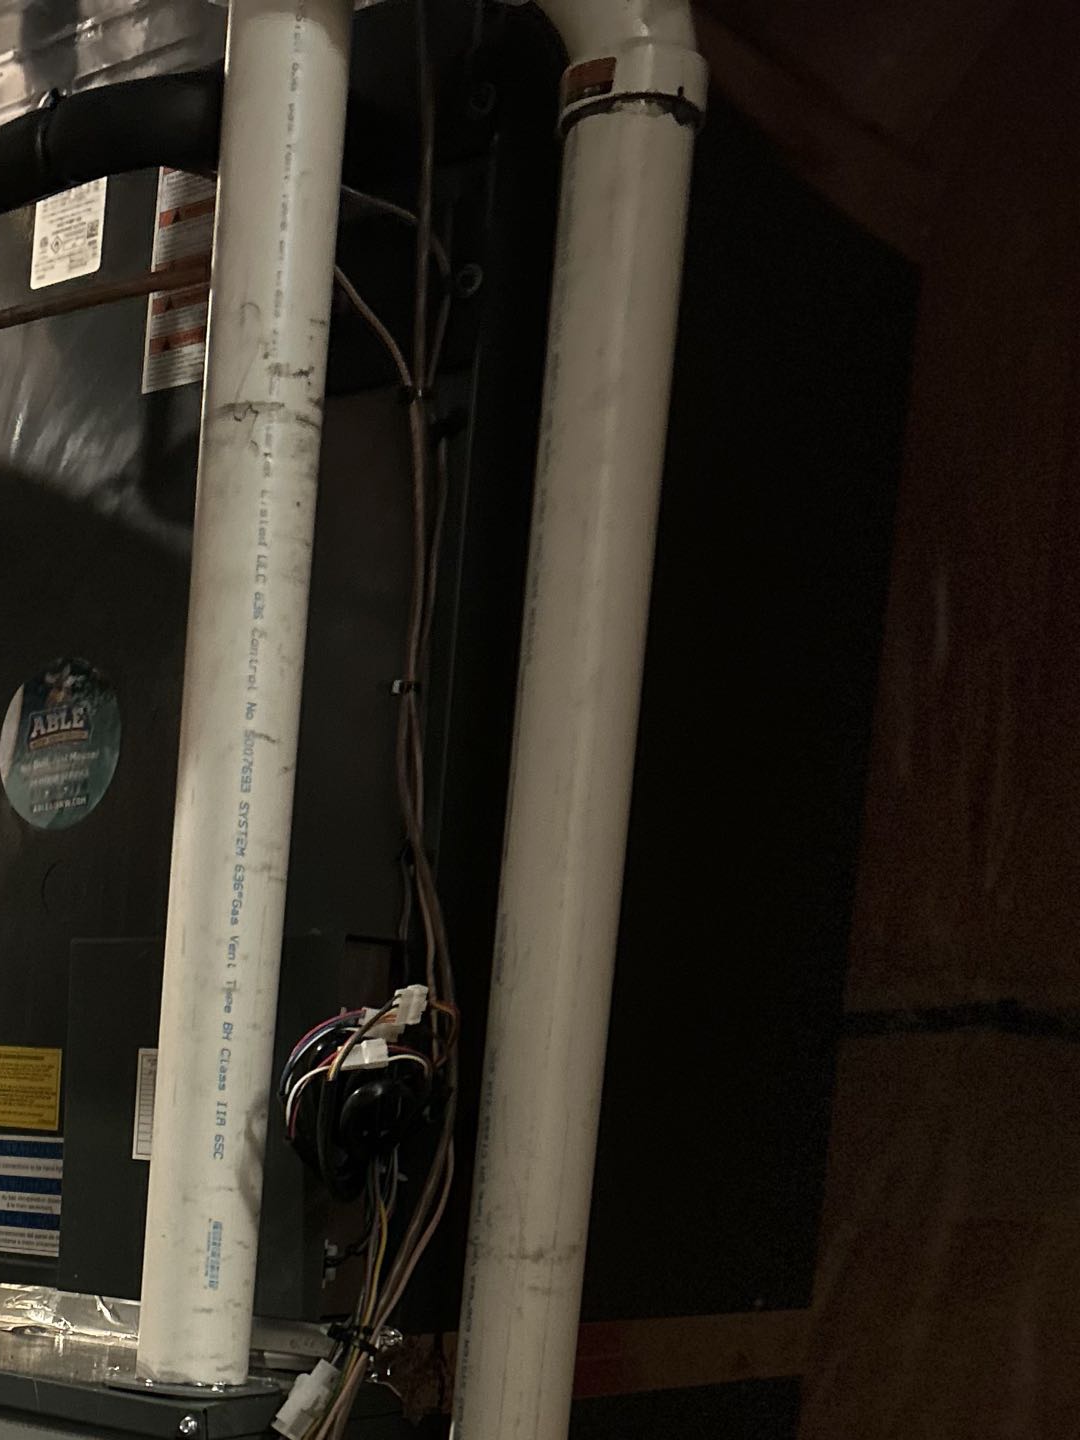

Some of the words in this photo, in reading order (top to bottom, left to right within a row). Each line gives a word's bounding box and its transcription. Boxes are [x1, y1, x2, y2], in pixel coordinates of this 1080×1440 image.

[31, 706, 86, 738] ABLE
[245, 702, 257, 721] No
[234, 800, 251, 857] SYSTEM
[226, 935, 240, 969] Vent
[216, 1047, 232, 1091] Class
